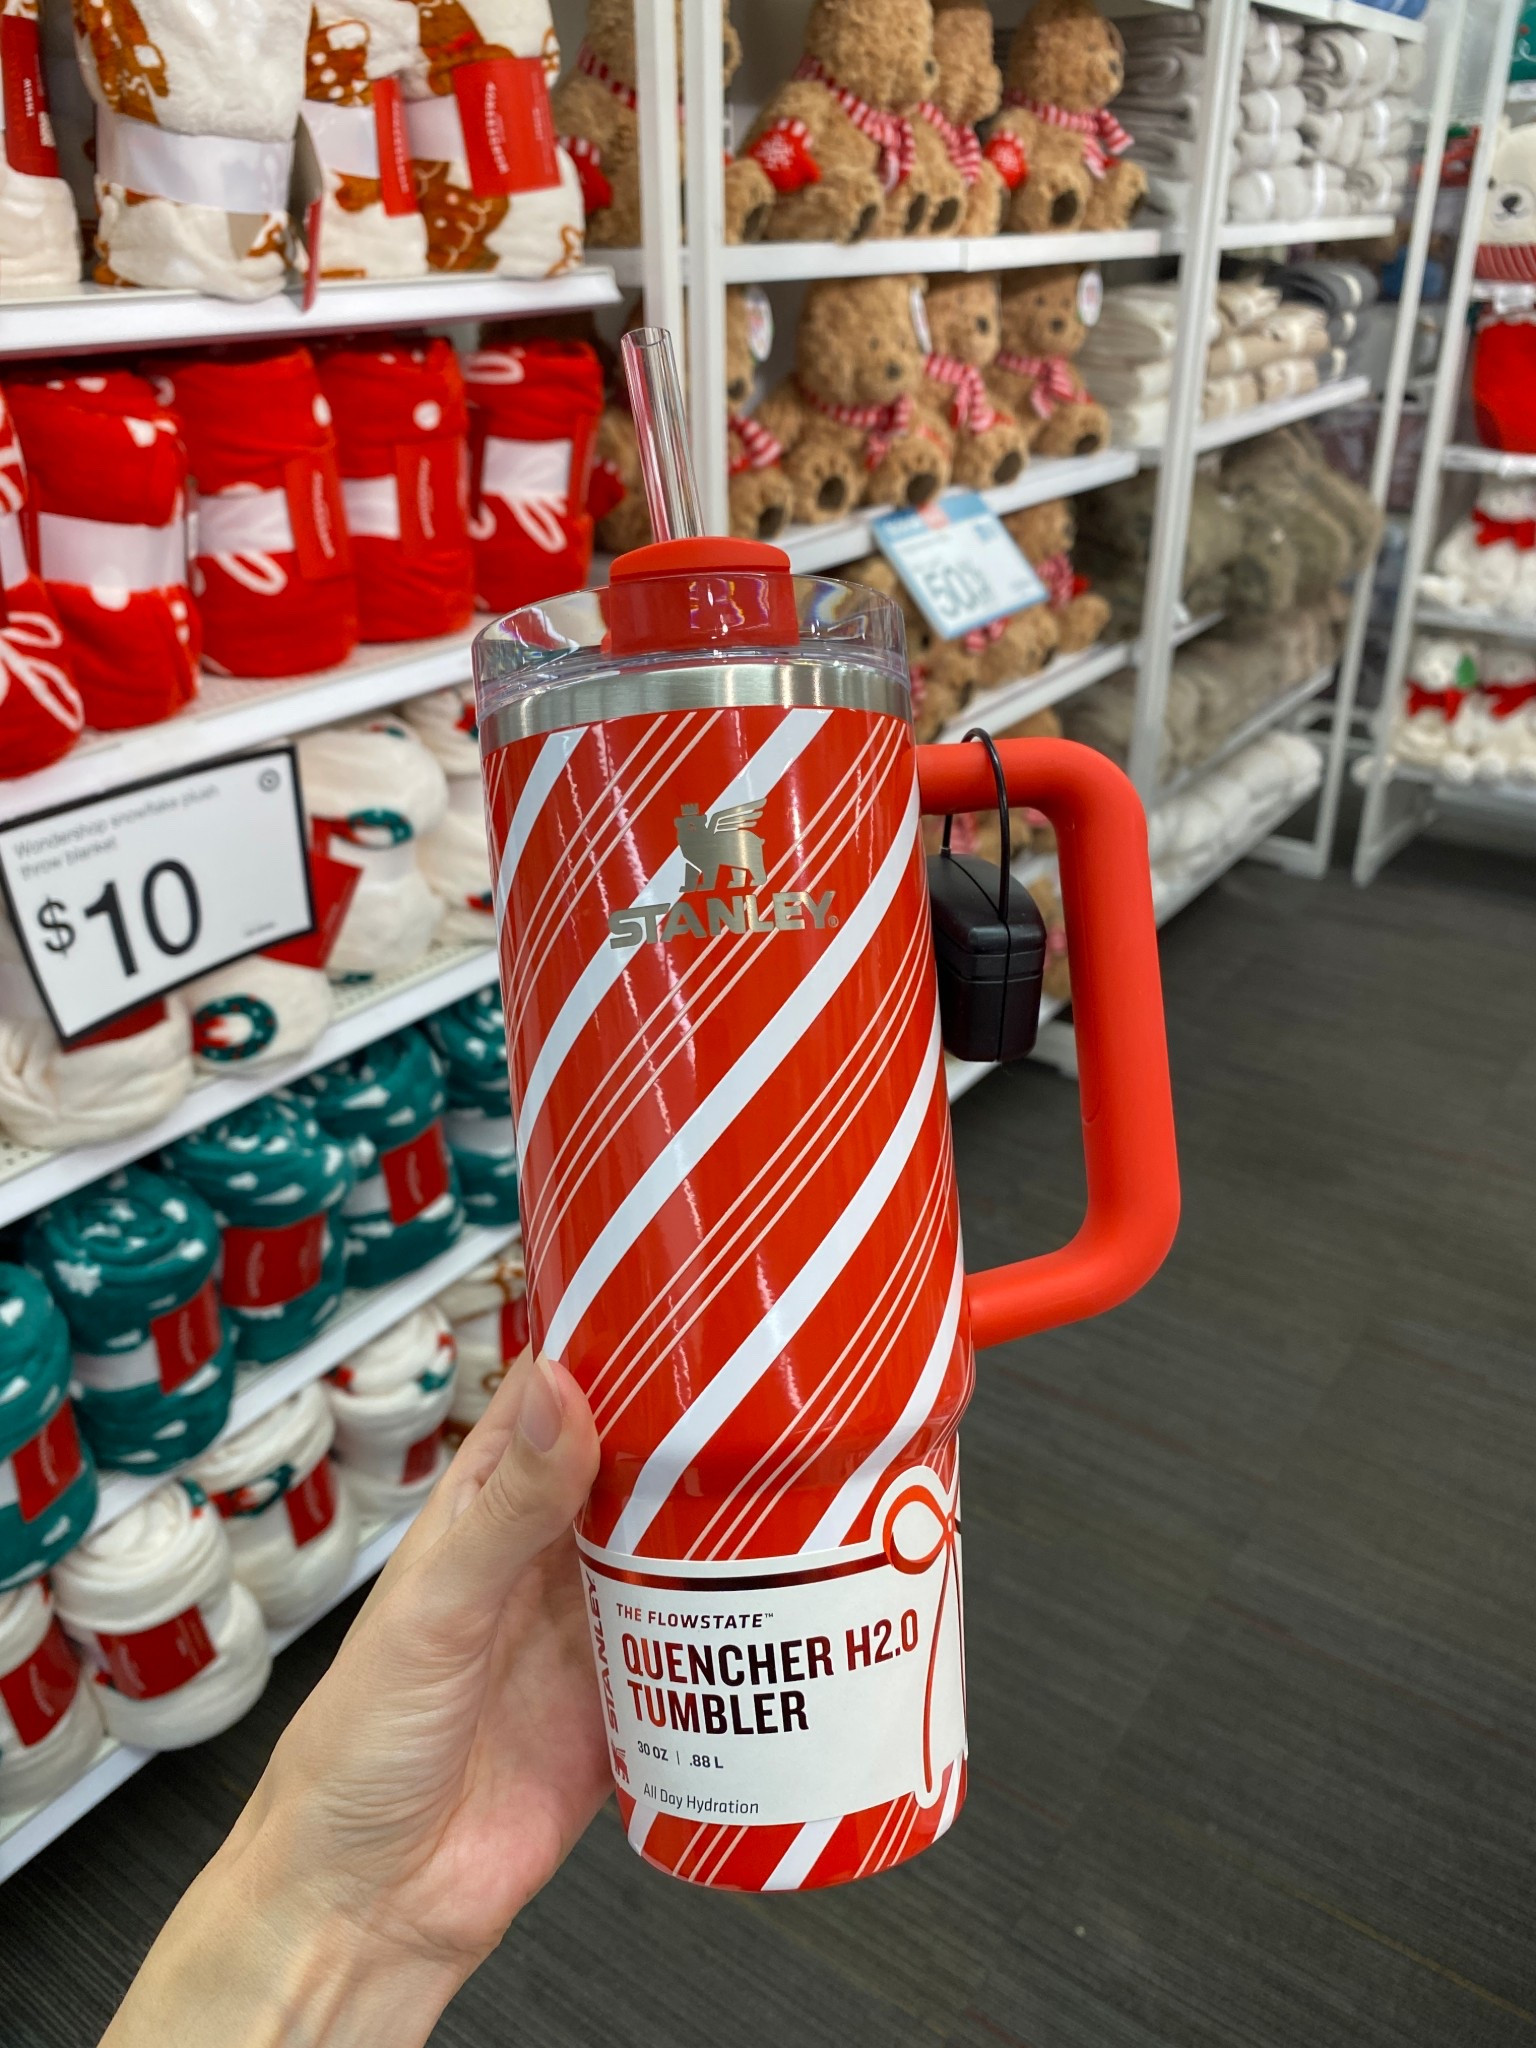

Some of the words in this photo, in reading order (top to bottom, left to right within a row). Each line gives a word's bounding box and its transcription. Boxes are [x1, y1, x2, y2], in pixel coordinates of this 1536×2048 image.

[12, 819, 109, 861] Wondershop
[19, 856, 62, 882] throw
[36, 857, 202, 978] $10
[616, 1603, 642, 1622] THE
[585, 1570, 620, 1734] STANLEY
[621, 1632, 835, 1687] QUENCHER
[845, 1608, 919, 1672] H2.0
[627, 1679, 810, 1735] TUMBLER
[637, 1740, 650, 1756] 30
[652, 1745, 669, 1762] OZ
[689, 1753, 711, 1769] .88
[714, 1755, 724, 1769] L
[643, 1782, 657, 1800] All
[660, 1788, 683, 1809] Day
[686, 1794, 760, 1815] Hydration
